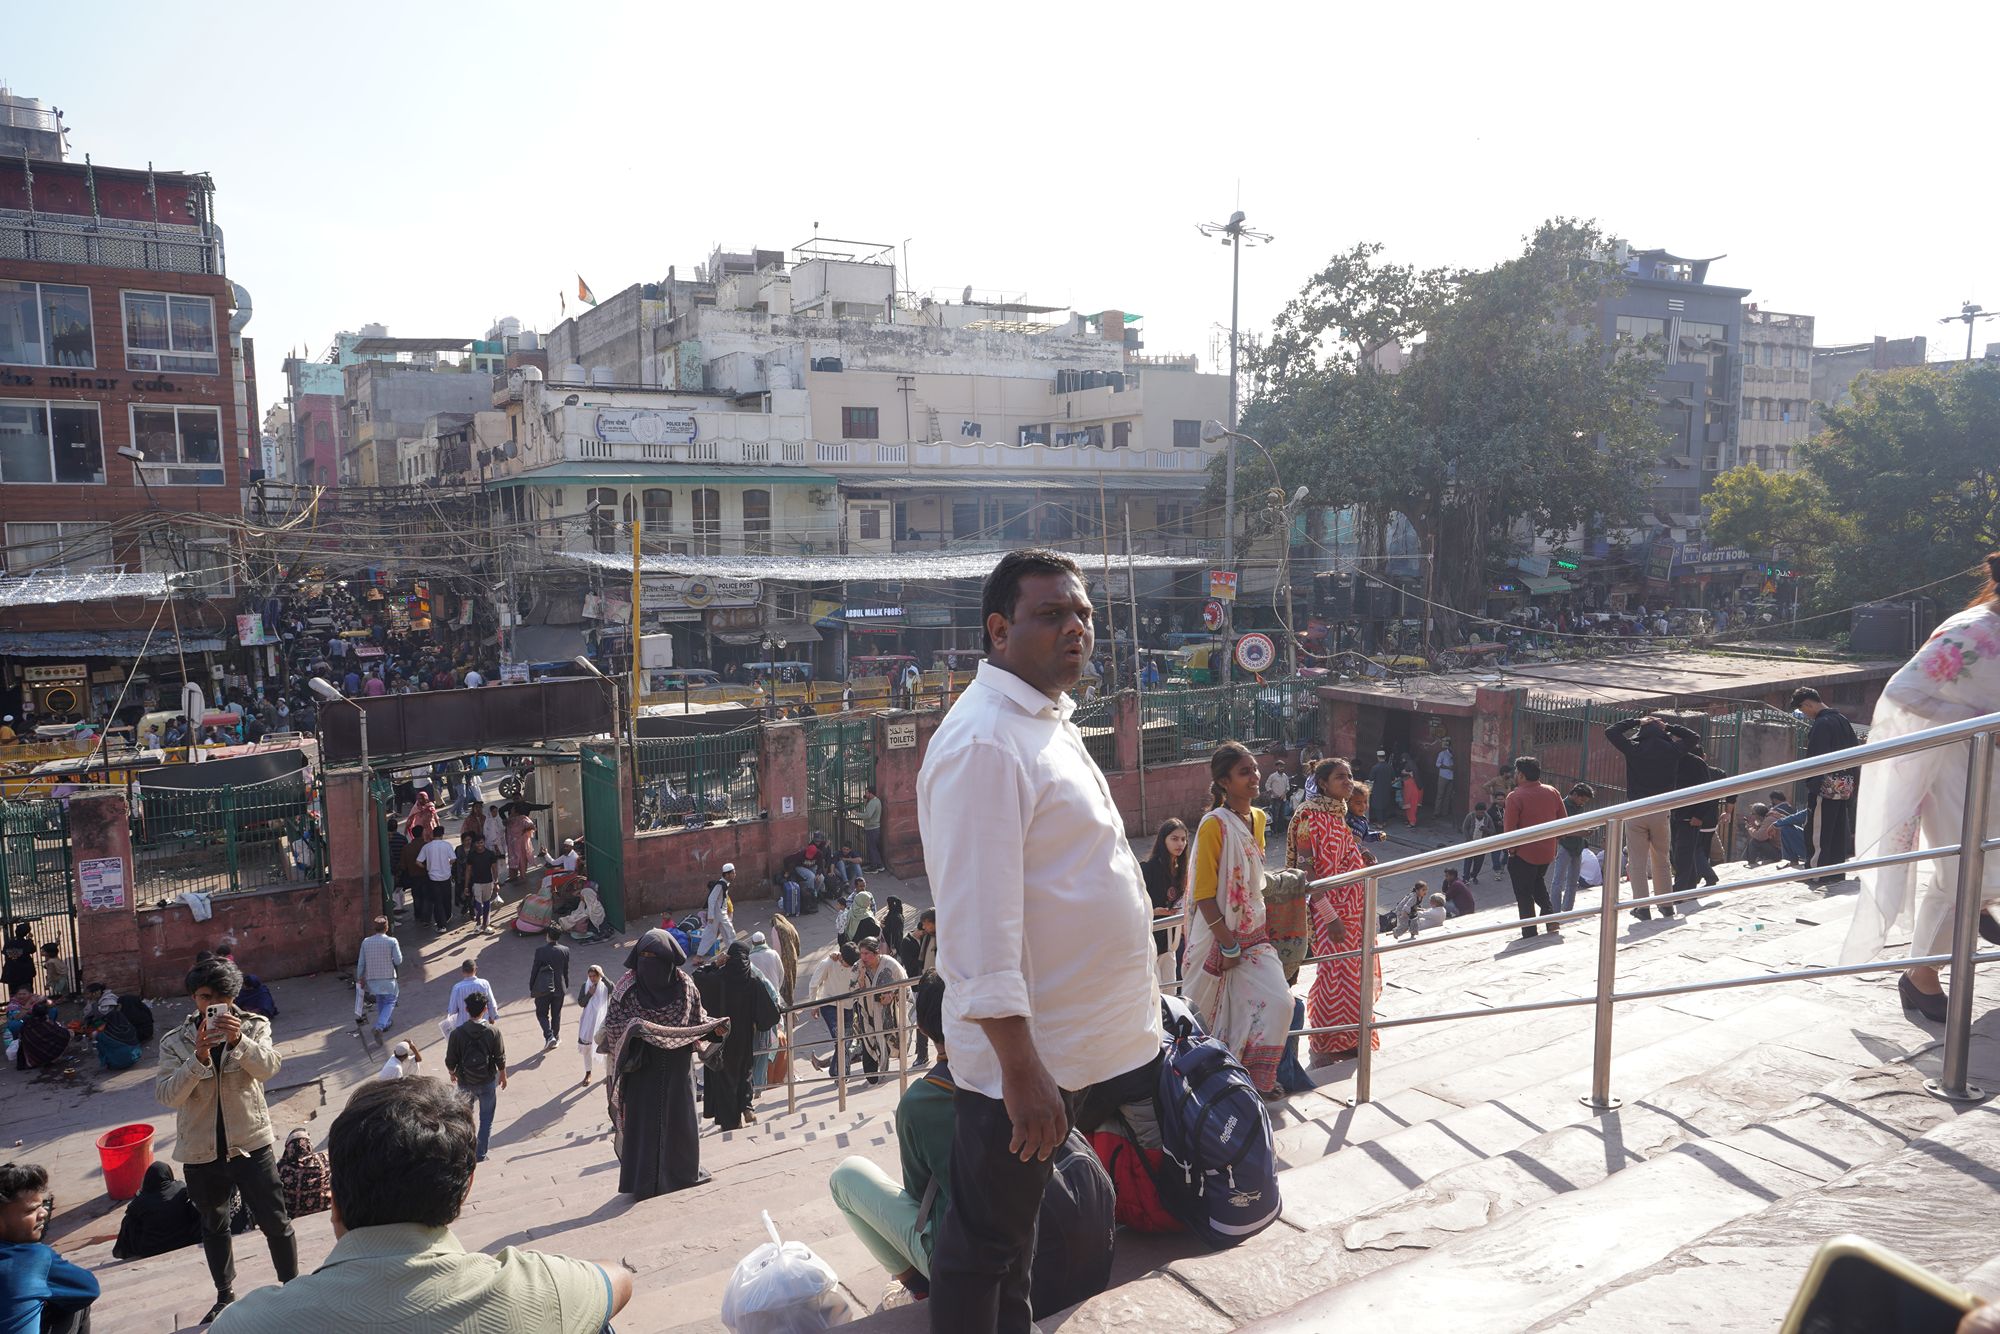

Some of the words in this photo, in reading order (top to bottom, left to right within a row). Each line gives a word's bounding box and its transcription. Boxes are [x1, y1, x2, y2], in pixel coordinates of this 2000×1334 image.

[1, 368, 33, 386] the
[50, 373, 118, 390] minar
[1702, 551, 1725, 562] GUEST
[845, 609, 864, 618] ABDUL
[865, 608, 883, 617] MALIK
[883, 607, 902, 616] FOODS
[889, 735, 915, 744] TOILETS
